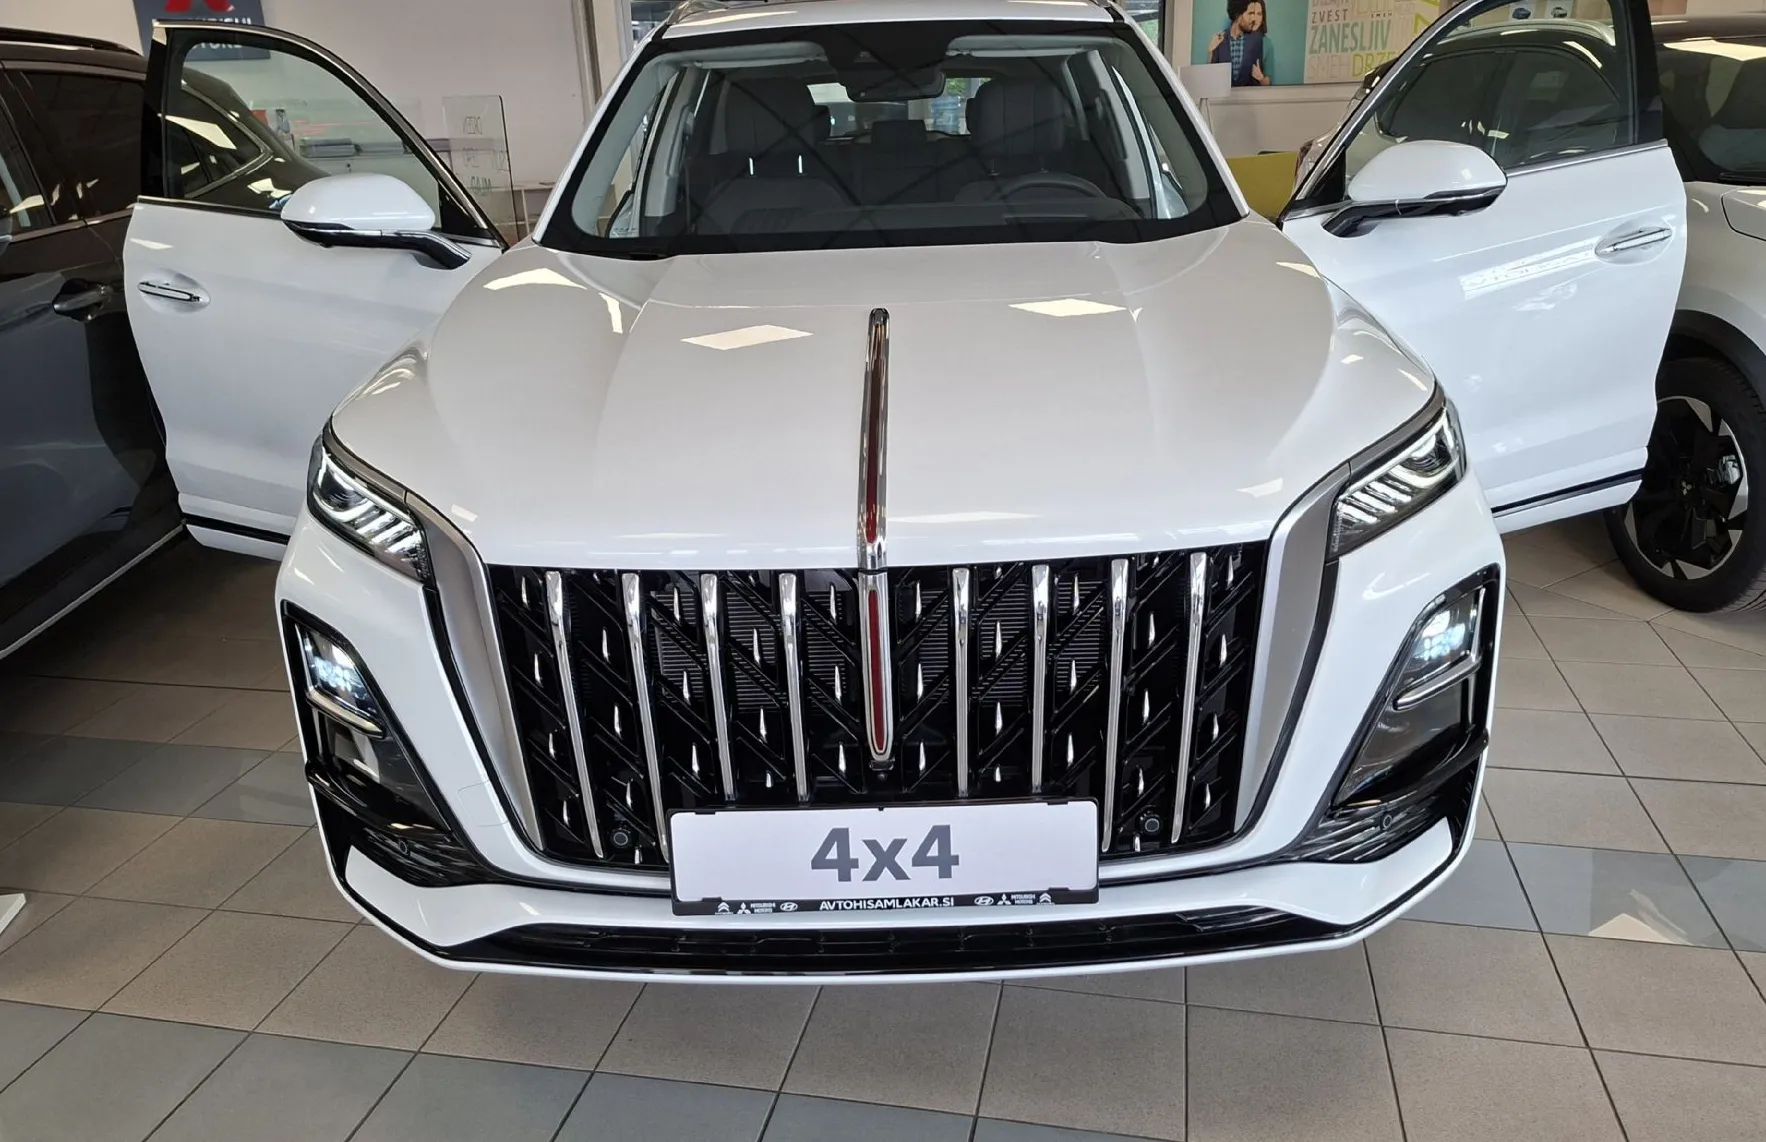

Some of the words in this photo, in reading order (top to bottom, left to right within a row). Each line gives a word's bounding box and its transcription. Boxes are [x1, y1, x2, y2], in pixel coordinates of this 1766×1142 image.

[1312, 8, 1348, 24] ZVEST
[1309, 19, 1391, 54] ZANESLJIV
[811, 825, 959, 882] 4x4
[819, 897, 955, 912] AVTOHISAMLAKAR.SI
